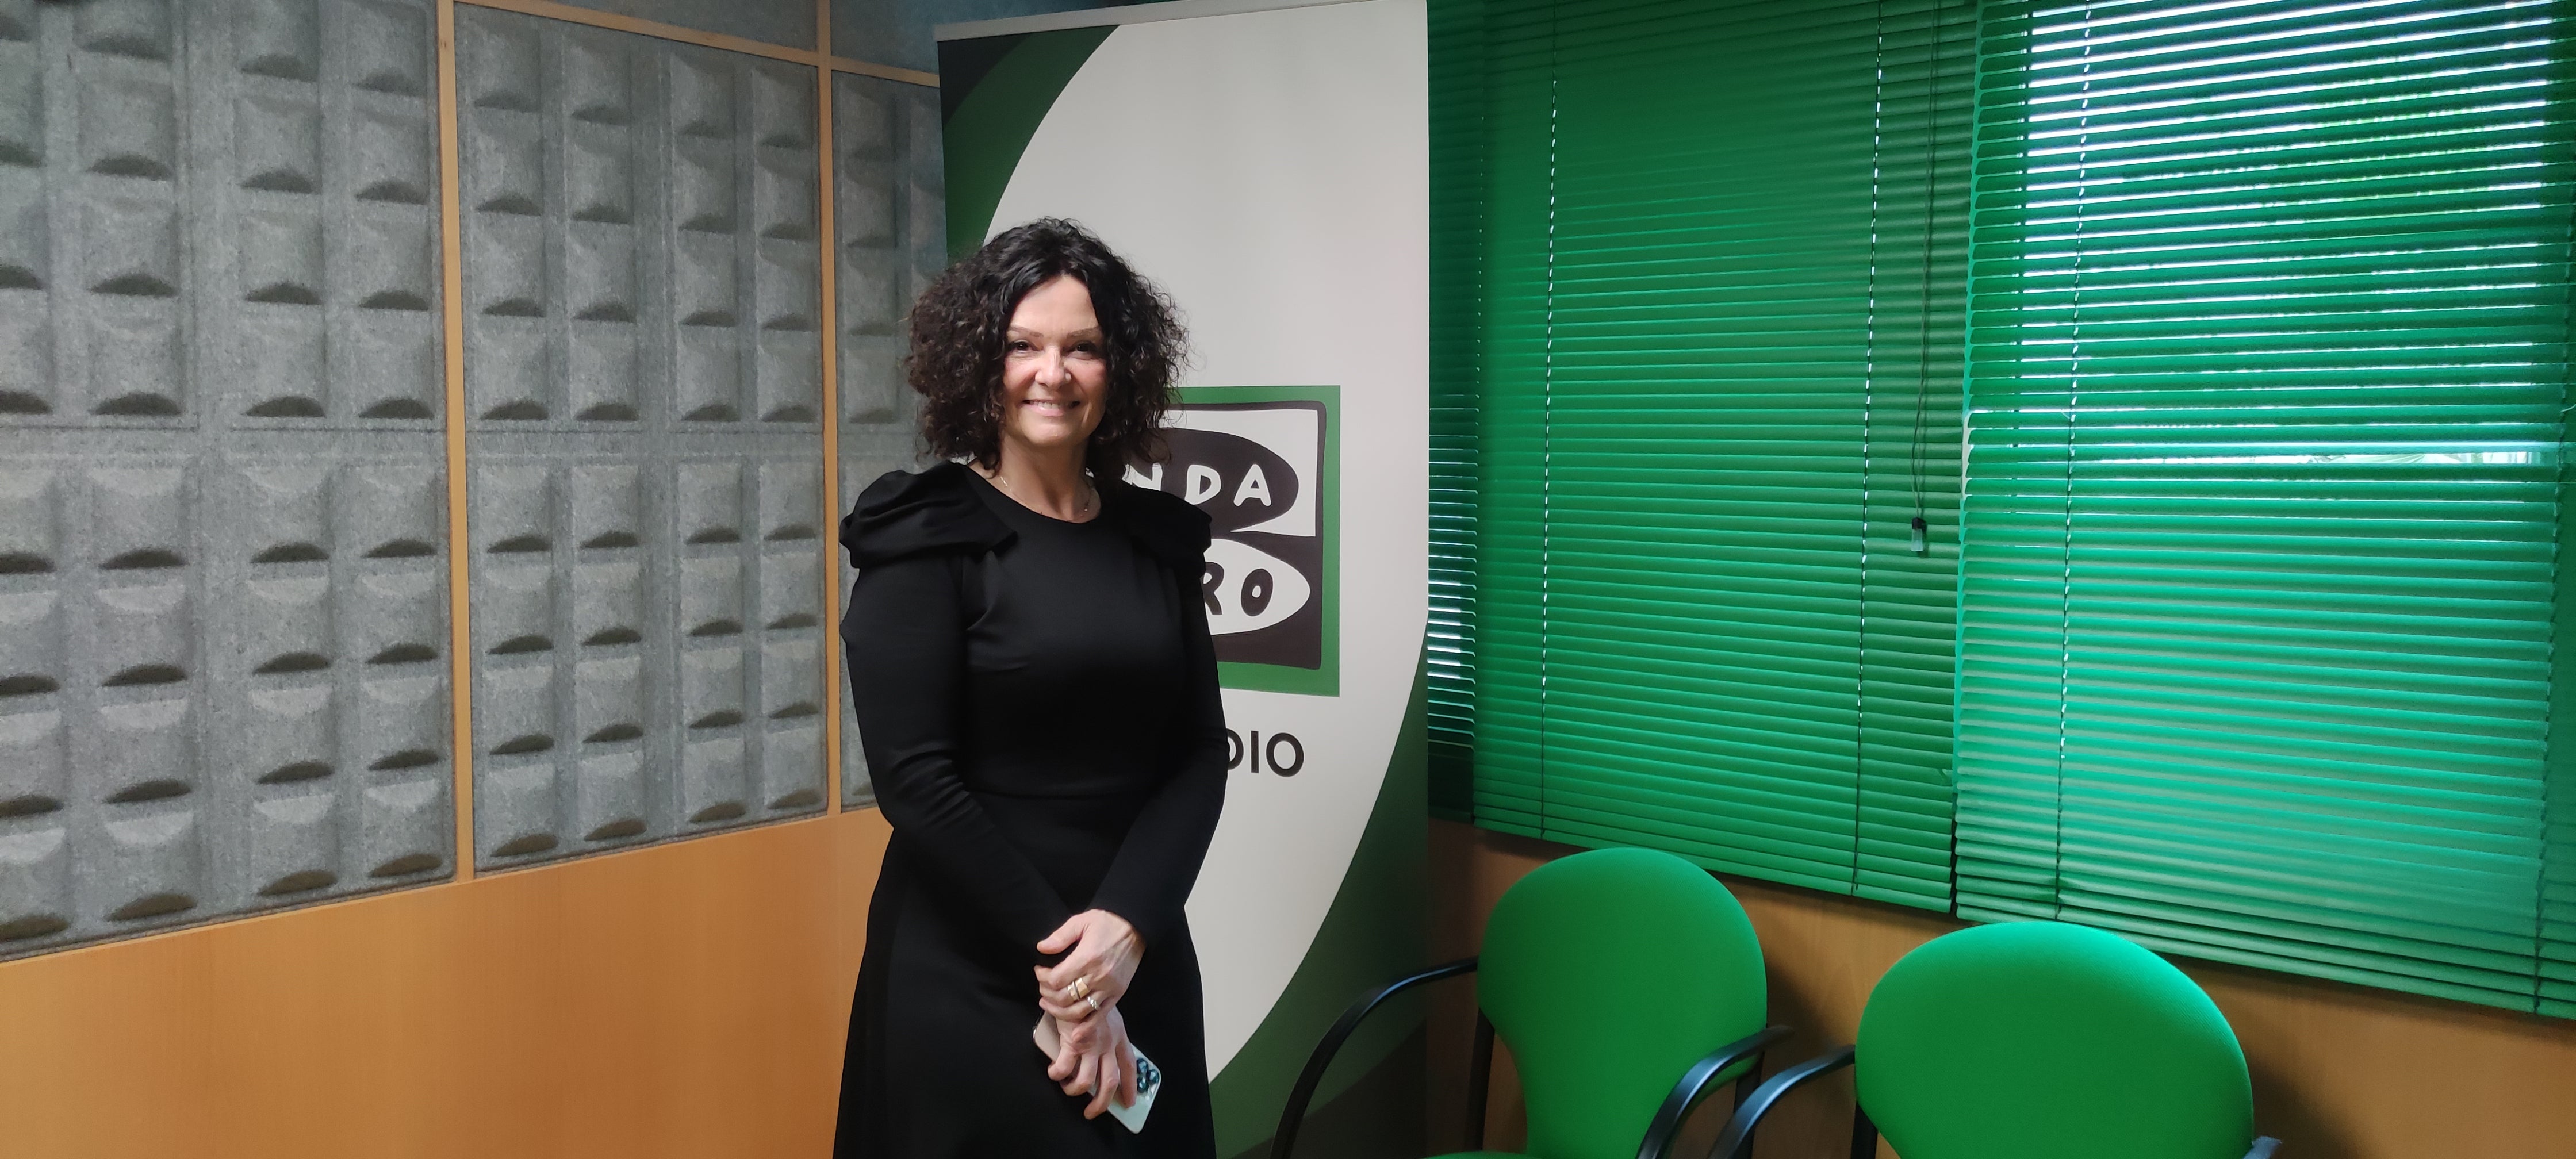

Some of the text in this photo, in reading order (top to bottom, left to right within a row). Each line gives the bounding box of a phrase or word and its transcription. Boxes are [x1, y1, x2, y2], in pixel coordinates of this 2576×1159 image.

[1121, 463, 1272, 506] NDA
[1199, 561, 1274, 617] RO
[1226, 728, 1304, 777] DIO
